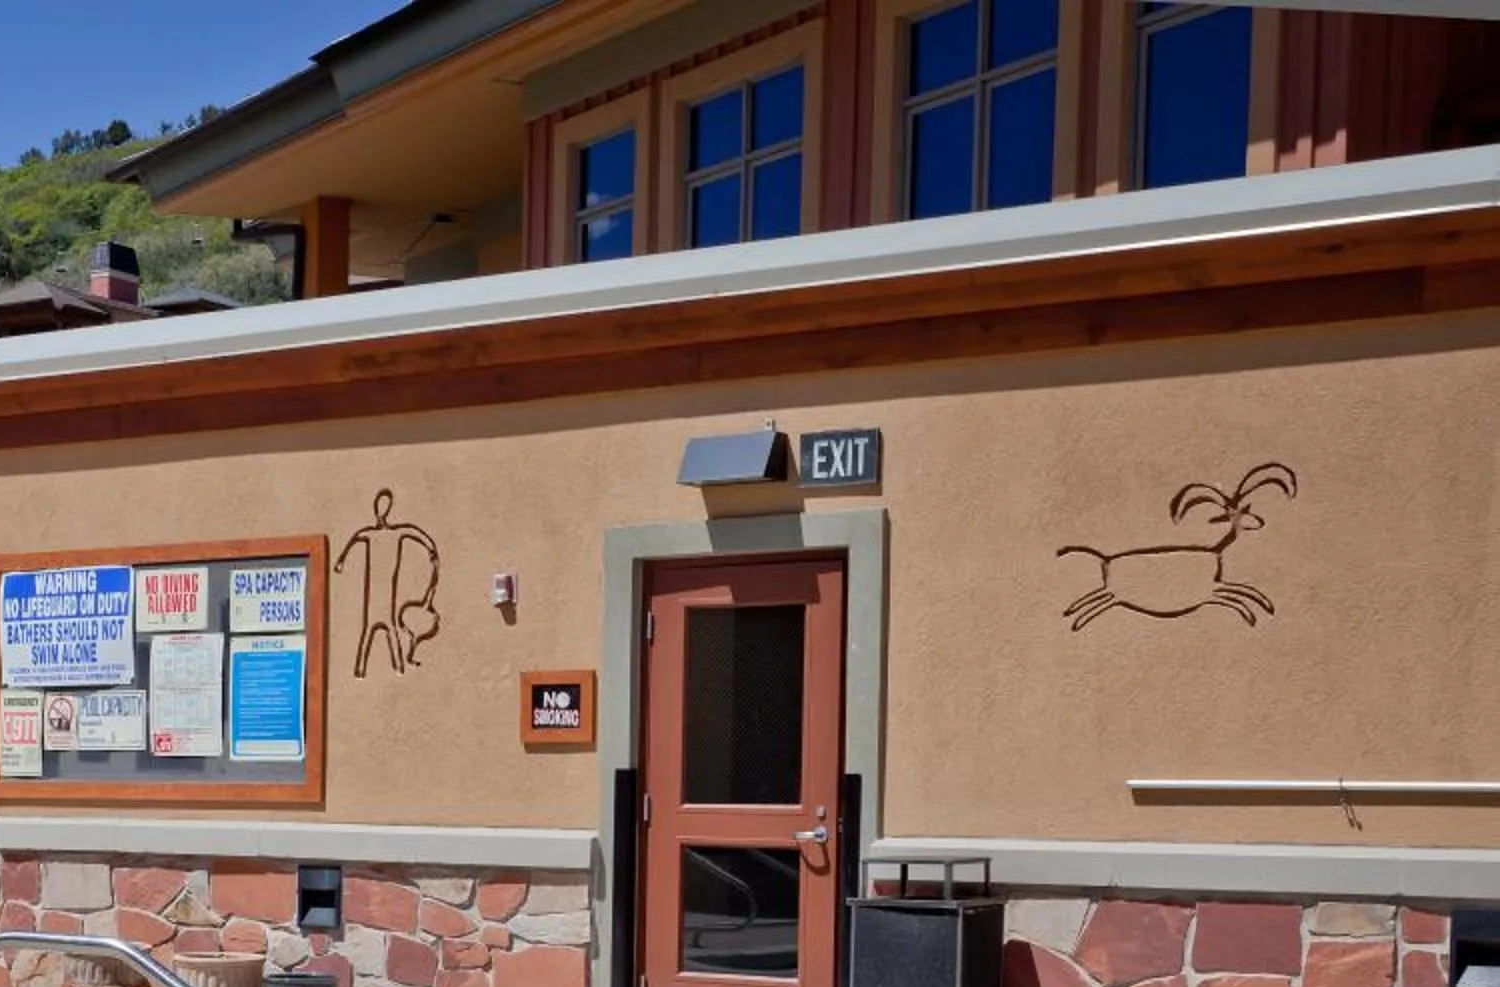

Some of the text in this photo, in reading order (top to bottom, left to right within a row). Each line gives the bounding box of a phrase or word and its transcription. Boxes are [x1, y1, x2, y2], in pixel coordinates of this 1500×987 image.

[812, 437, 869, 479] EXIT
[35, 570, 97, 595] WARNING
[145, 572, 199, 595] NO DIVING
[235, 571, 302, 596] SPA CAPACITY
[4, 591, 128, 618] NO LIFEGUARD ON DUTY
[147, 593, 198, 615] ALLOWED
[259, 601, 301, 623] PERSONS
[6, 619, 125, 645] BATHERS SHOULD NOT
[31, 642, 98, 666] SWIM ALONE
[542, 691, 571, 709] NO
[533, 708, 580, 727] SMOKING
